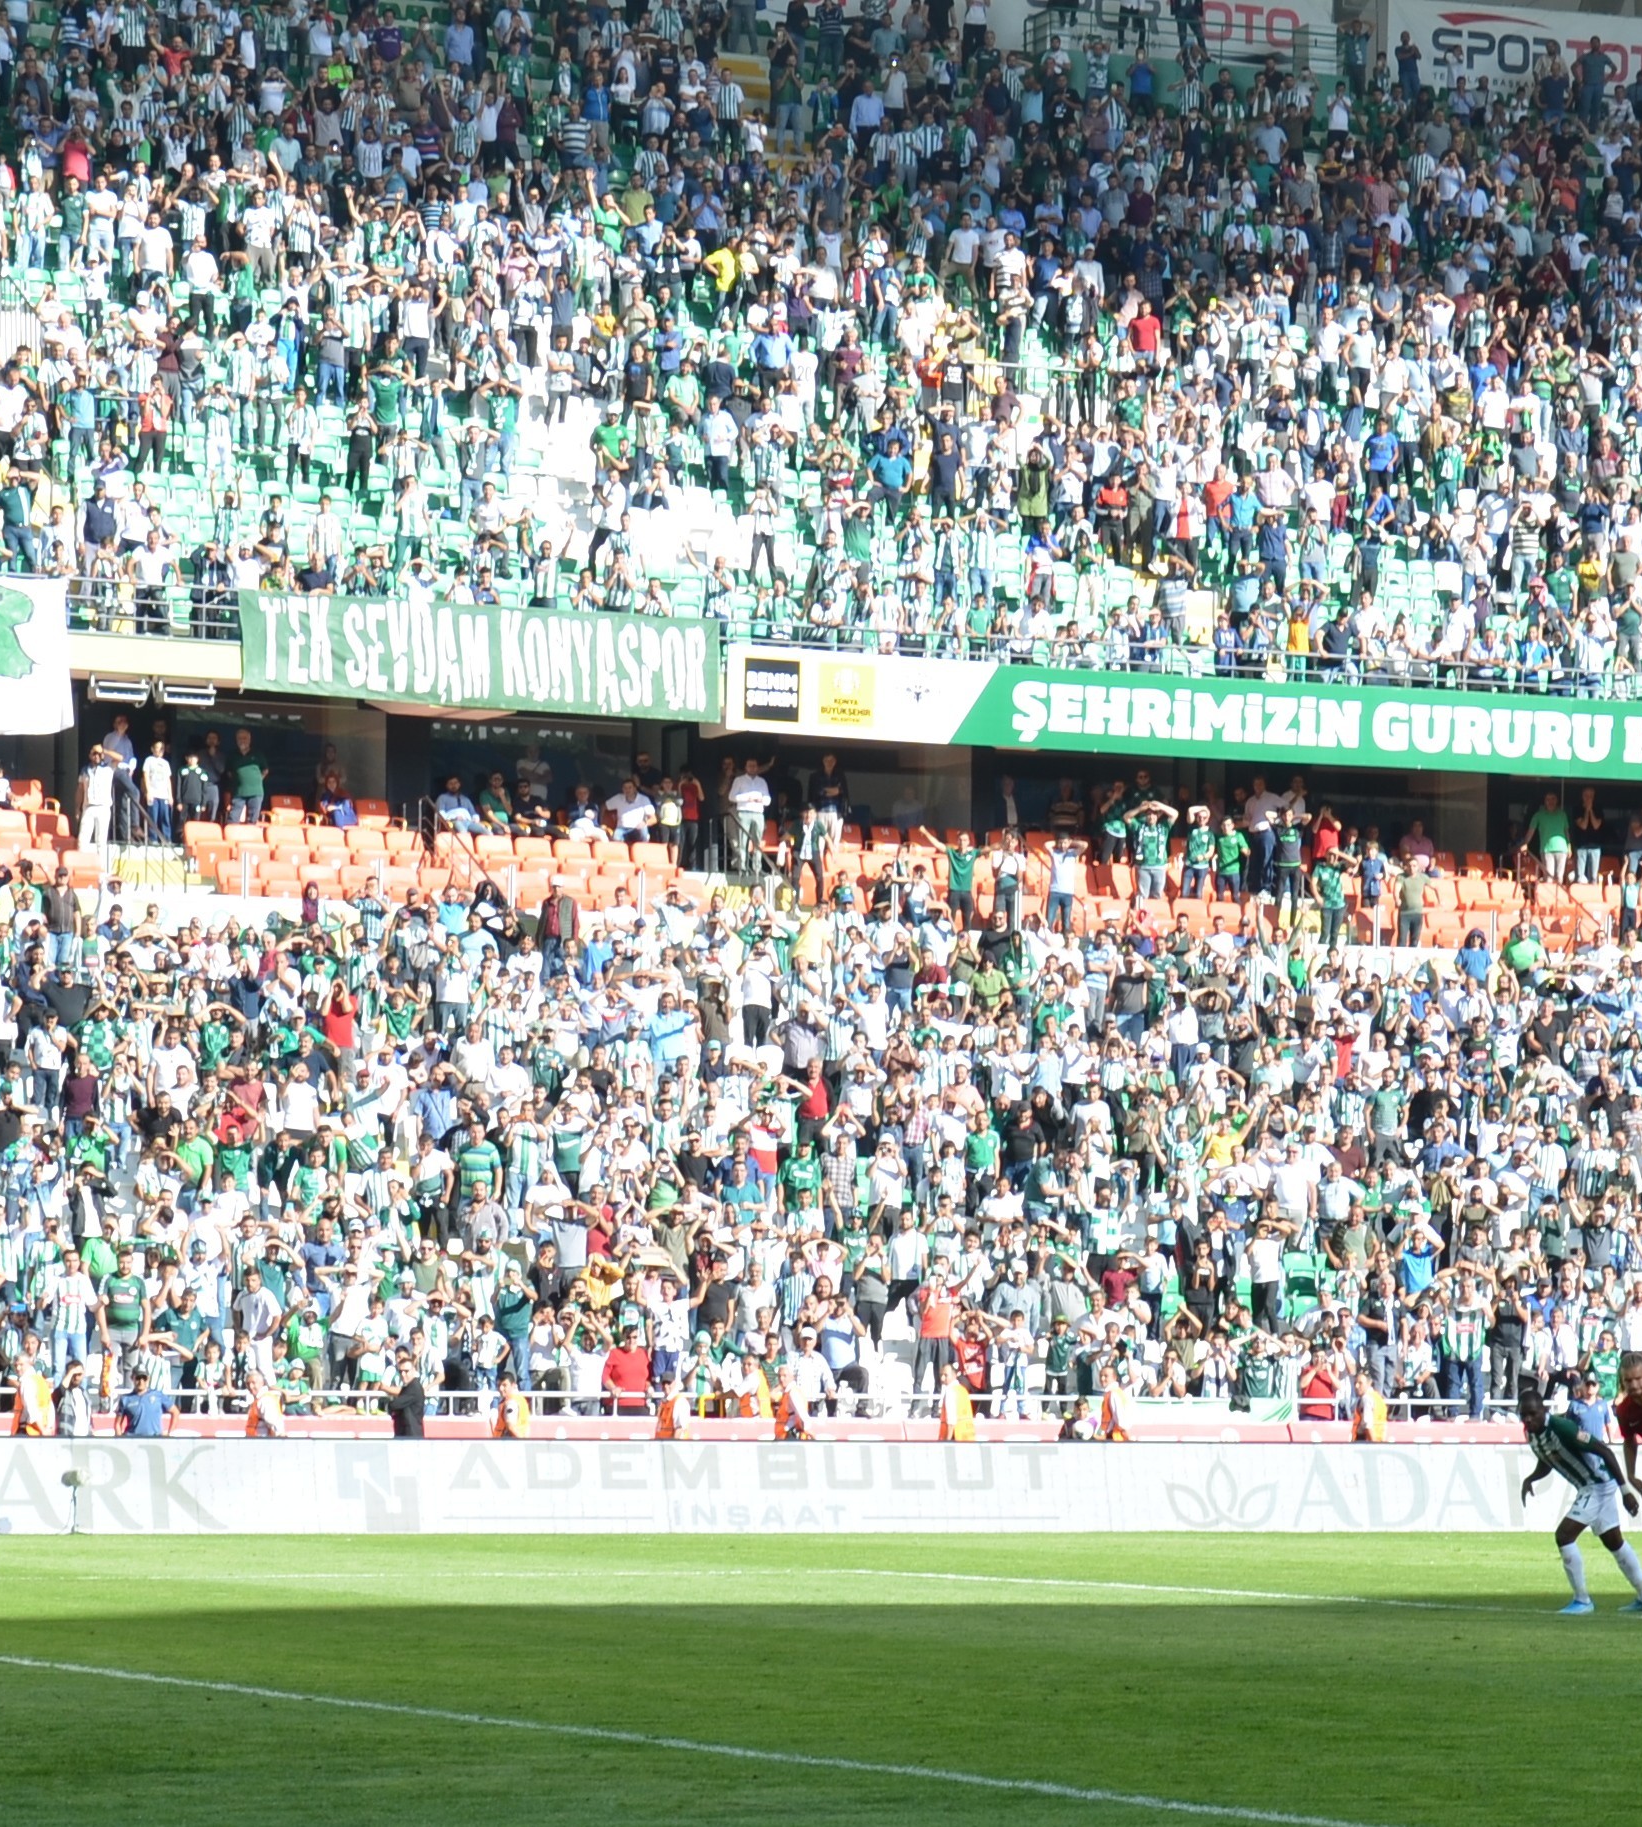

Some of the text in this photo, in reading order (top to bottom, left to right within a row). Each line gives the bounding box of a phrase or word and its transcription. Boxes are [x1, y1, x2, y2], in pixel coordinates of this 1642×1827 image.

[259, 595, 707, 714] TEK SEVDAM KONYASPOR
[1012, 680, 1361, 749] ŞEHRİMİZİN
[1371, 698, 1616, 763] GURURU
[448, 1440, 1059, 1488] ADEM BULUT
[673, 1497, 847, 1531] İNŞAAT
